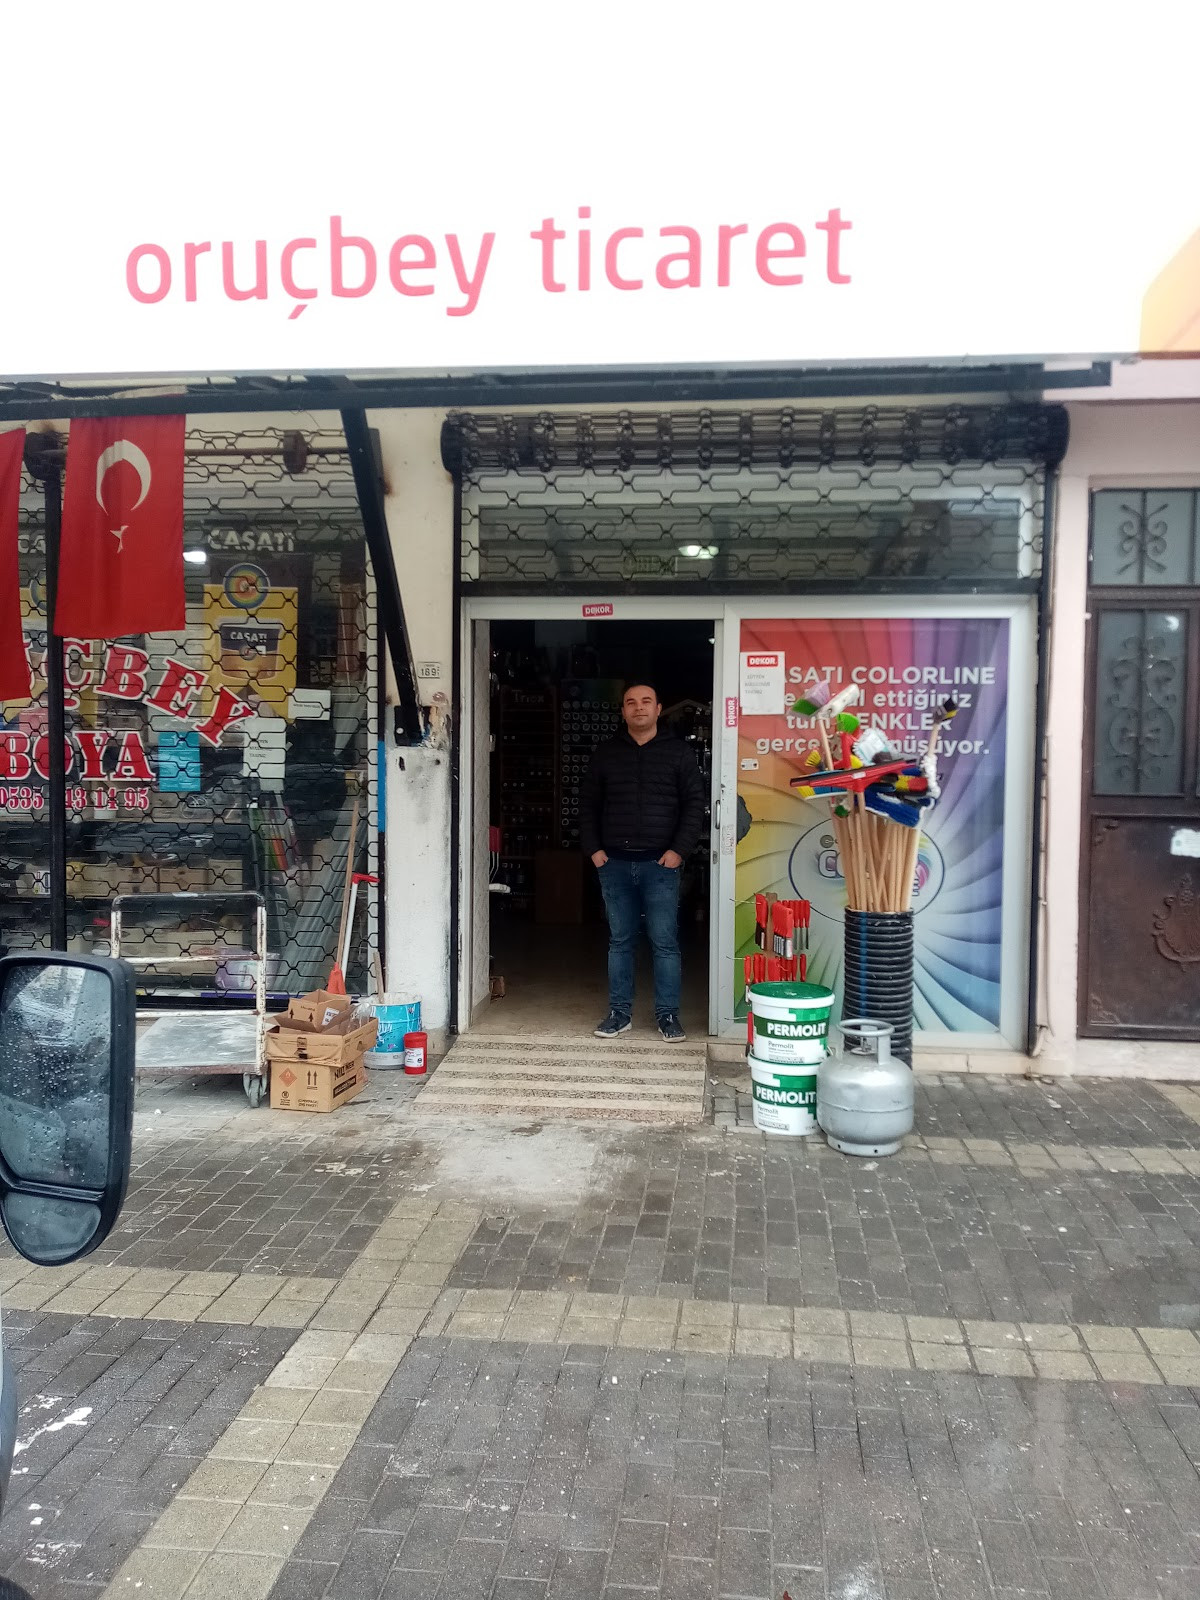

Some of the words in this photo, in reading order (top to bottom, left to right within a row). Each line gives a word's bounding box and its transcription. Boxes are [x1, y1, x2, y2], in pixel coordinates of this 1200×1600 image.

[126, 215, 495, 319] oruçbey
[530, 205, 853, 293] ticaret
[851, 666, 996, 686] COLORLINE
[124, 786, 149, 811] 95
